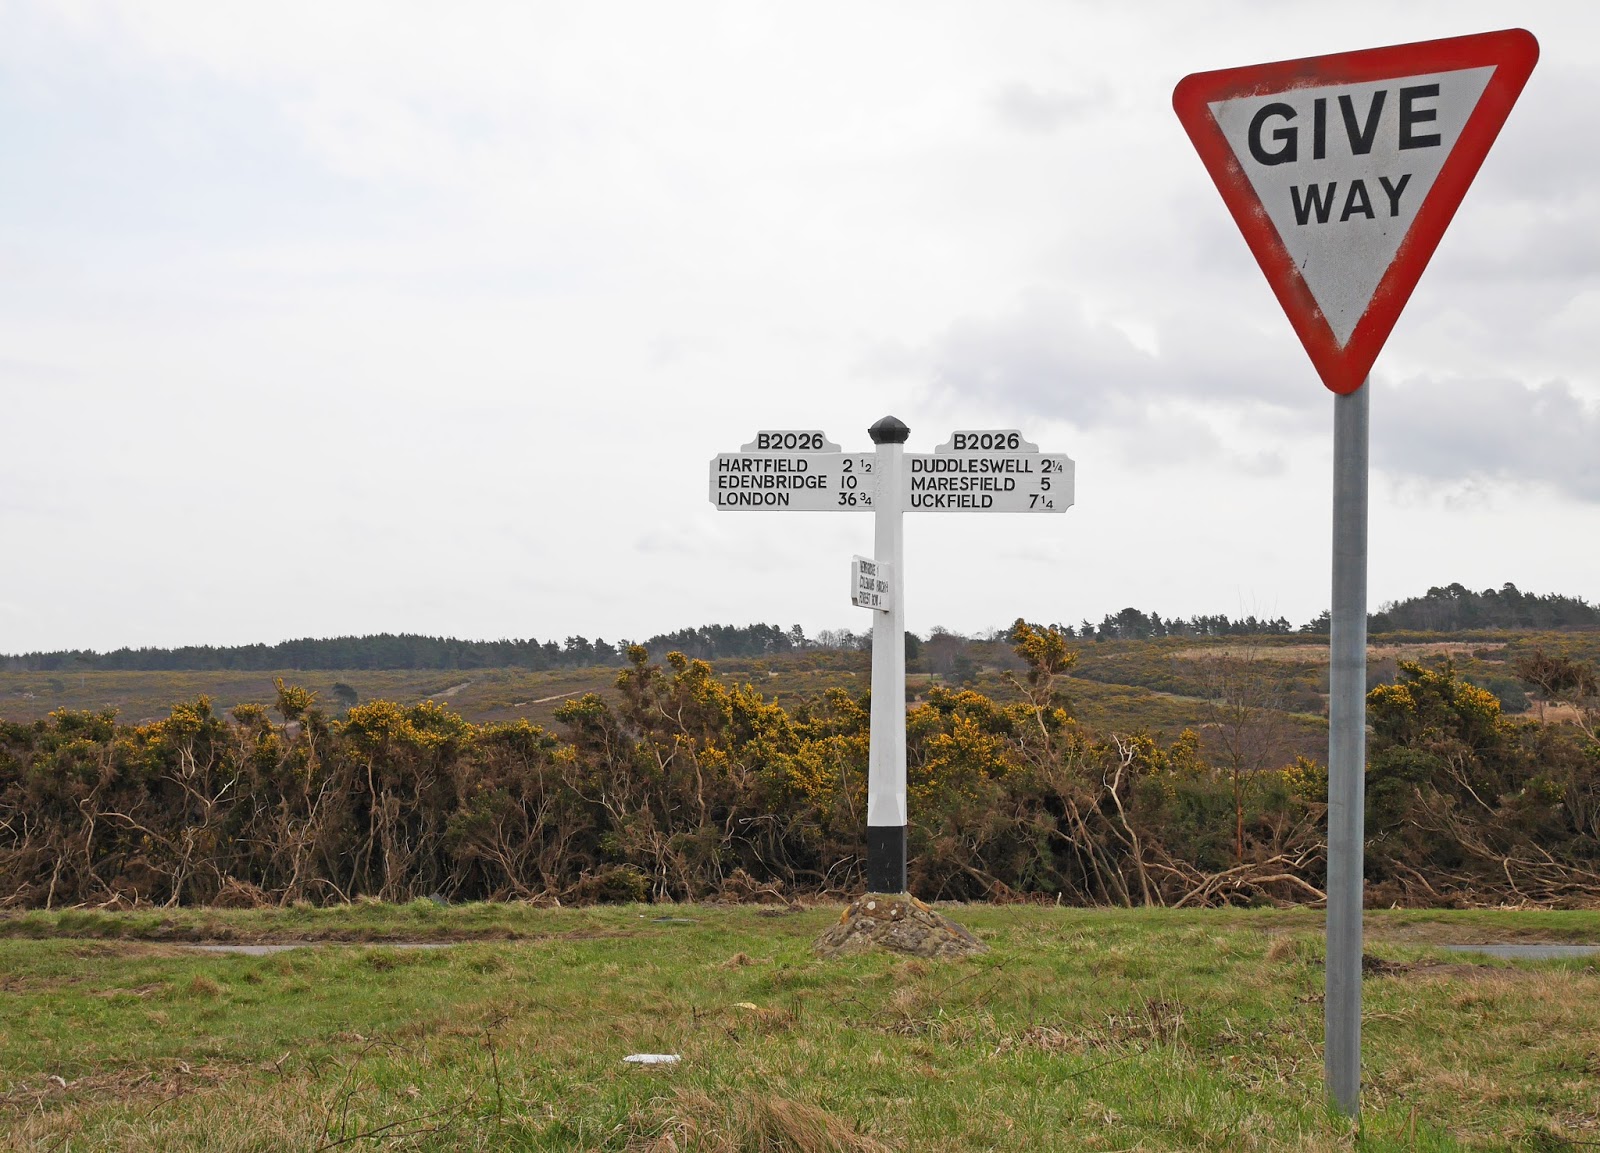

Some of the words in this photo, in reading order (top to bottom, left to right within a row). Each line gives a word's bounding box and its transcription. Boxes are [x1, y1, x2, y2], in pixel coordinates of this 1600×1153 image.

[1247, 83, 1442, 166] GIVE
[1289, 173, 1413, 226] WAY
[757, 433, 824, 450] B2026
[953, 433, 1020, 450] B2026
[718, 458, 808, 473] HARTFIELD
[911, 458, 1033, 473] DUDDLESWELL
[718, 475, 828, 489] EDENBRIDGE
[841, 475, 858, 489] 10
[911, 476, 1016, 491] MARESFIELD
[1040, 477, 1051, 491] 5
[718, 492, 790, 506] LONDON
[911, 494, 993, 508] UCKFIELD
